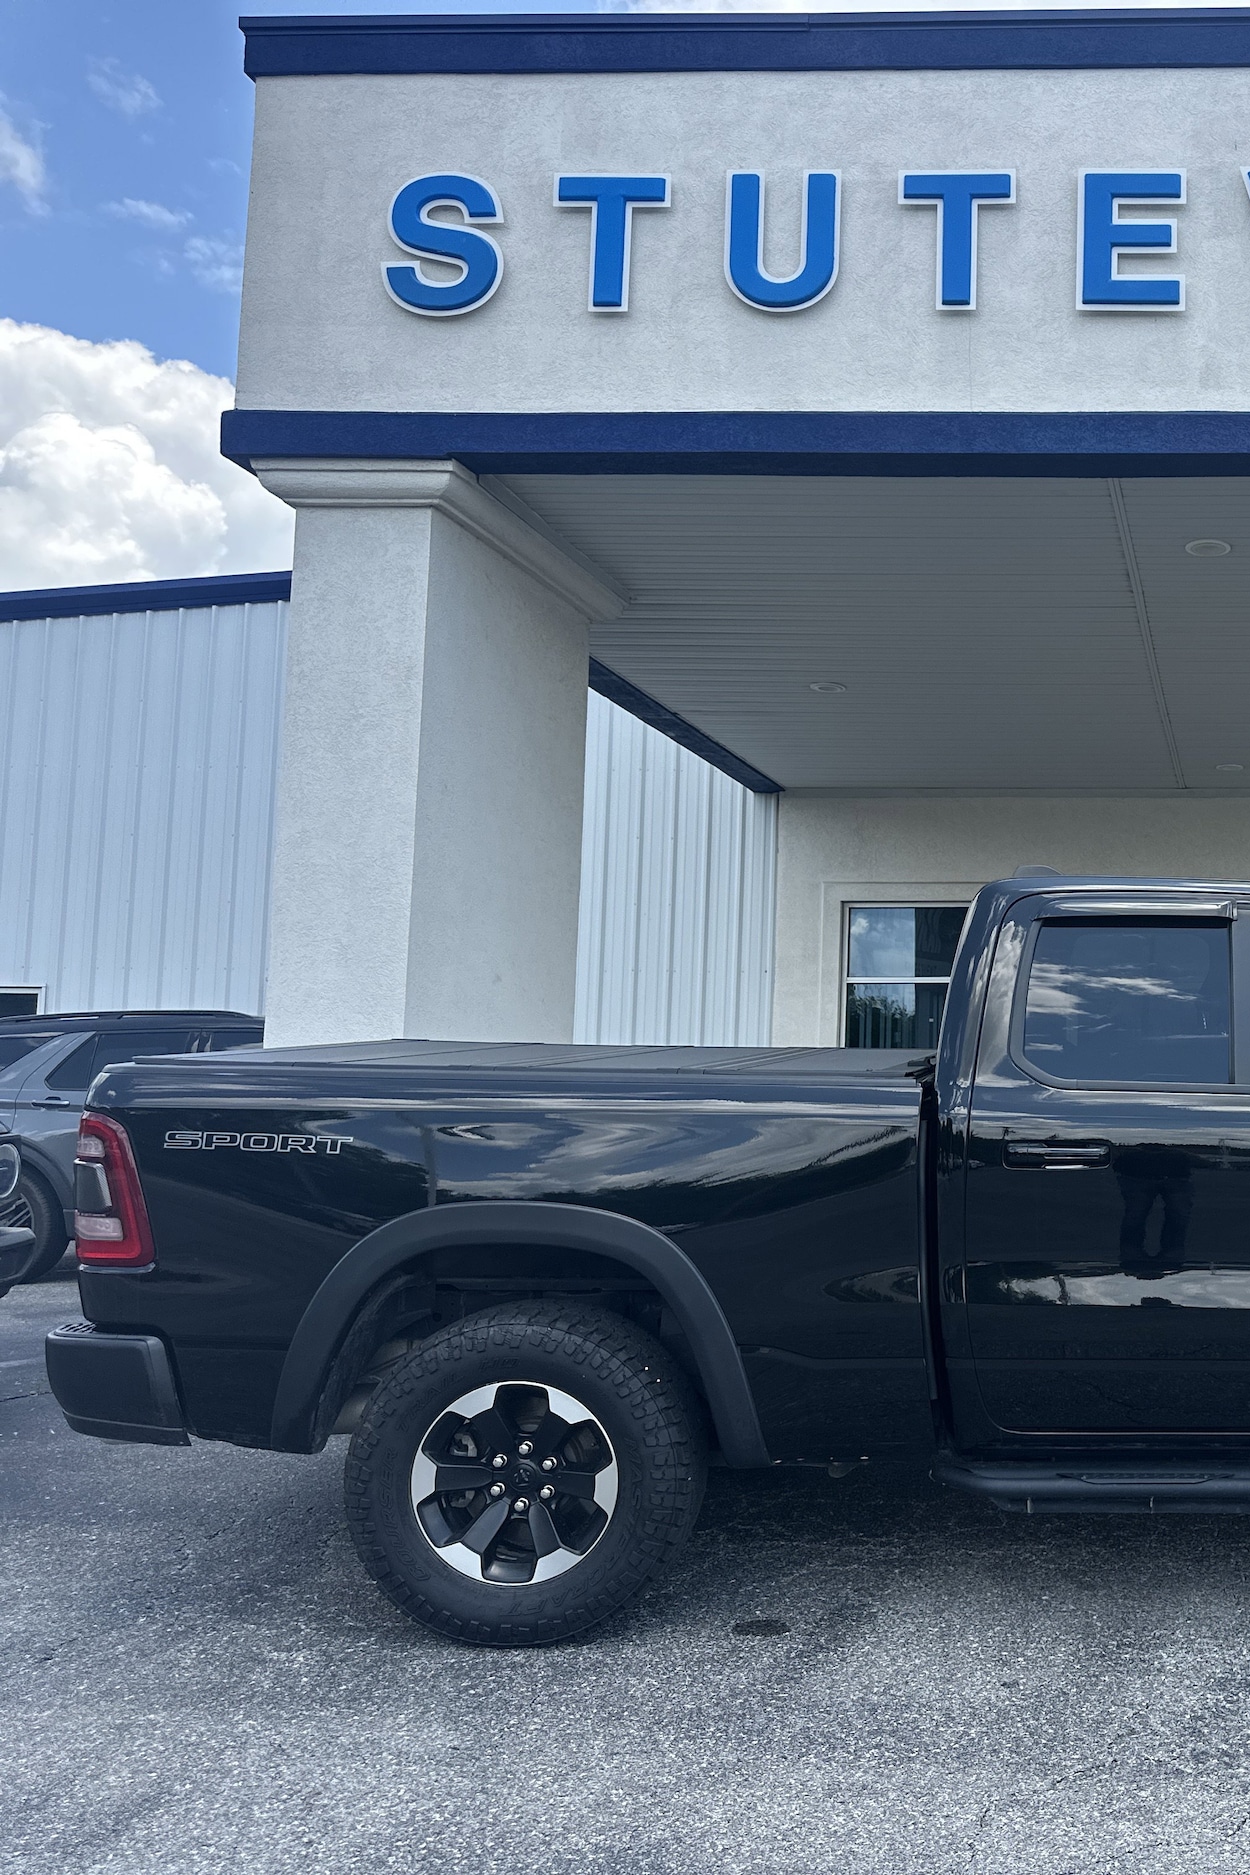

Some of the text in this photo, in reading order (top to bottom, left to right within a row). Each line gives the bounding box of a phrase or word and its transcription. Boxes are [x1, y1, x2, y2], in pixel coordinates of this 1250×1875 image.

[163, 1130, 354, 1155] SPORT
[396, 1372, 465, 1432] TRAIL
[378, 1447, 431, 1582] COURSER
